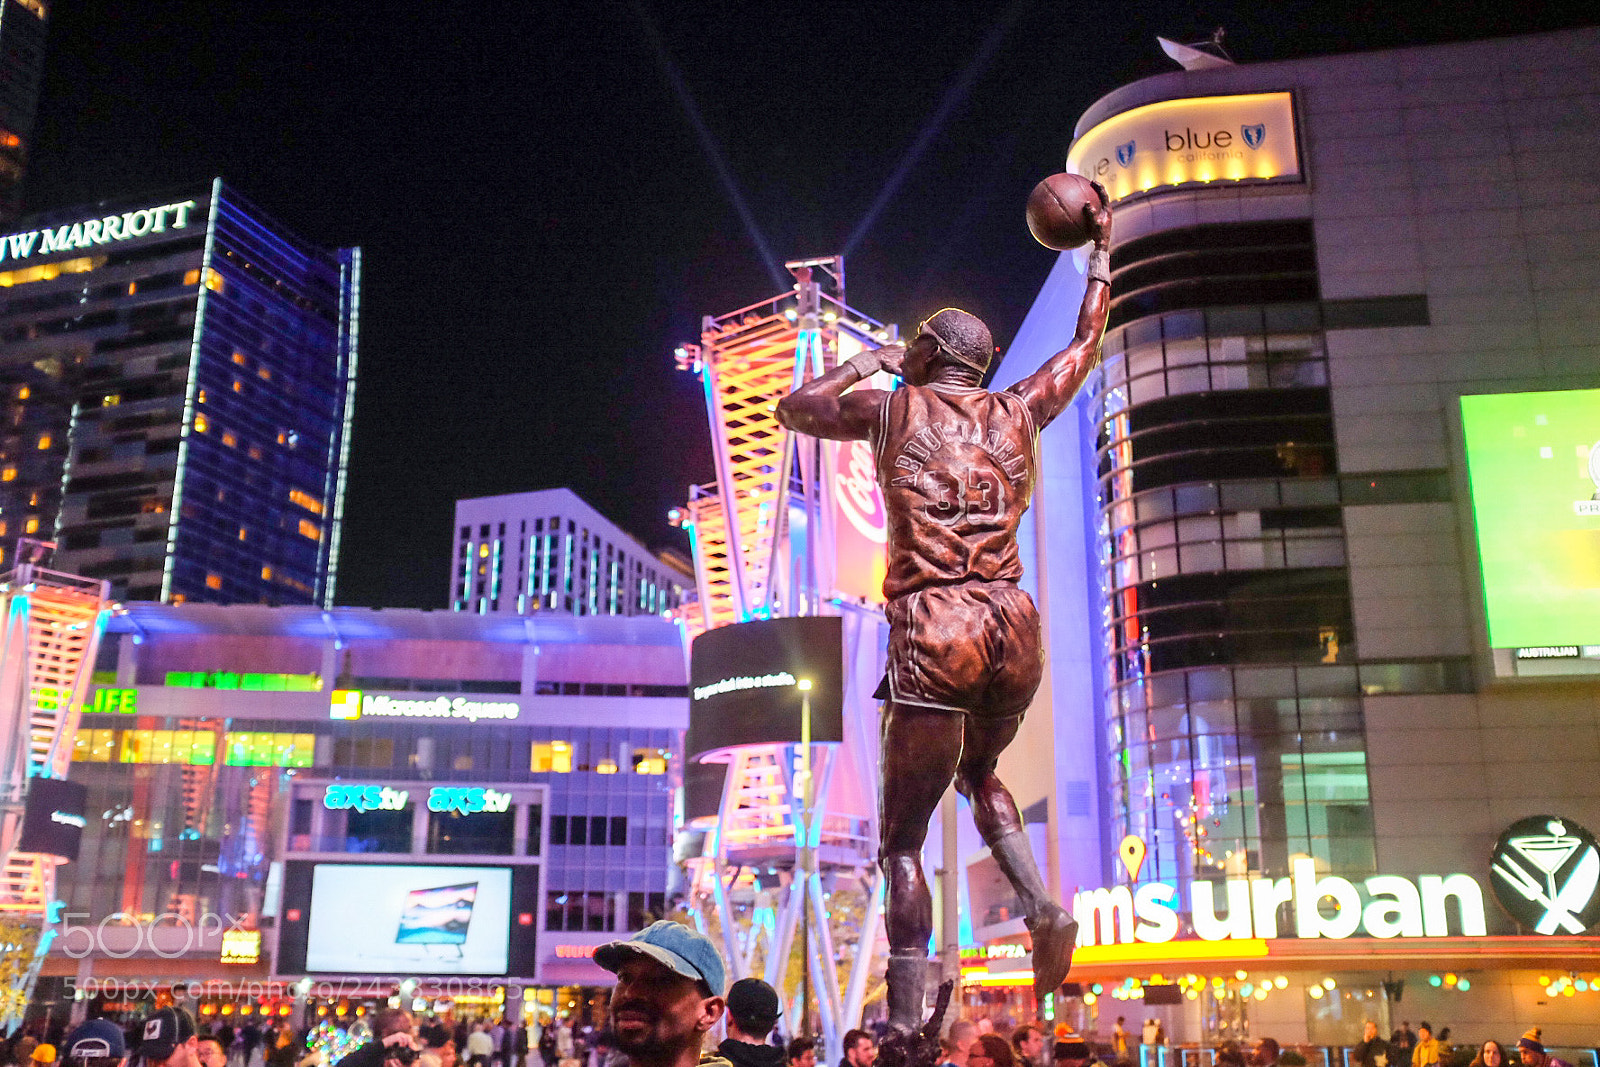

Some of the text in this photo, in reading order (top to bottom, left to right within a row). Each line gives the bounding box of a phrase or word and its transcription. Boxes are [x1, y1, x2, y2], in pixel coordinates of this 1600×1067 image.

[1165, 127, 1232, 152] blue
[38, 200, 196, 254] MARRIOTT
[924, 467, 1005, 526] 33
[1579, 504, 1600, 513] PR
[1519, 646, 1578, 658] AUSTRALIAN
[362, 695, 520, 722] Microsoft Square
[1073, 857, 1487, 947] ms urban
